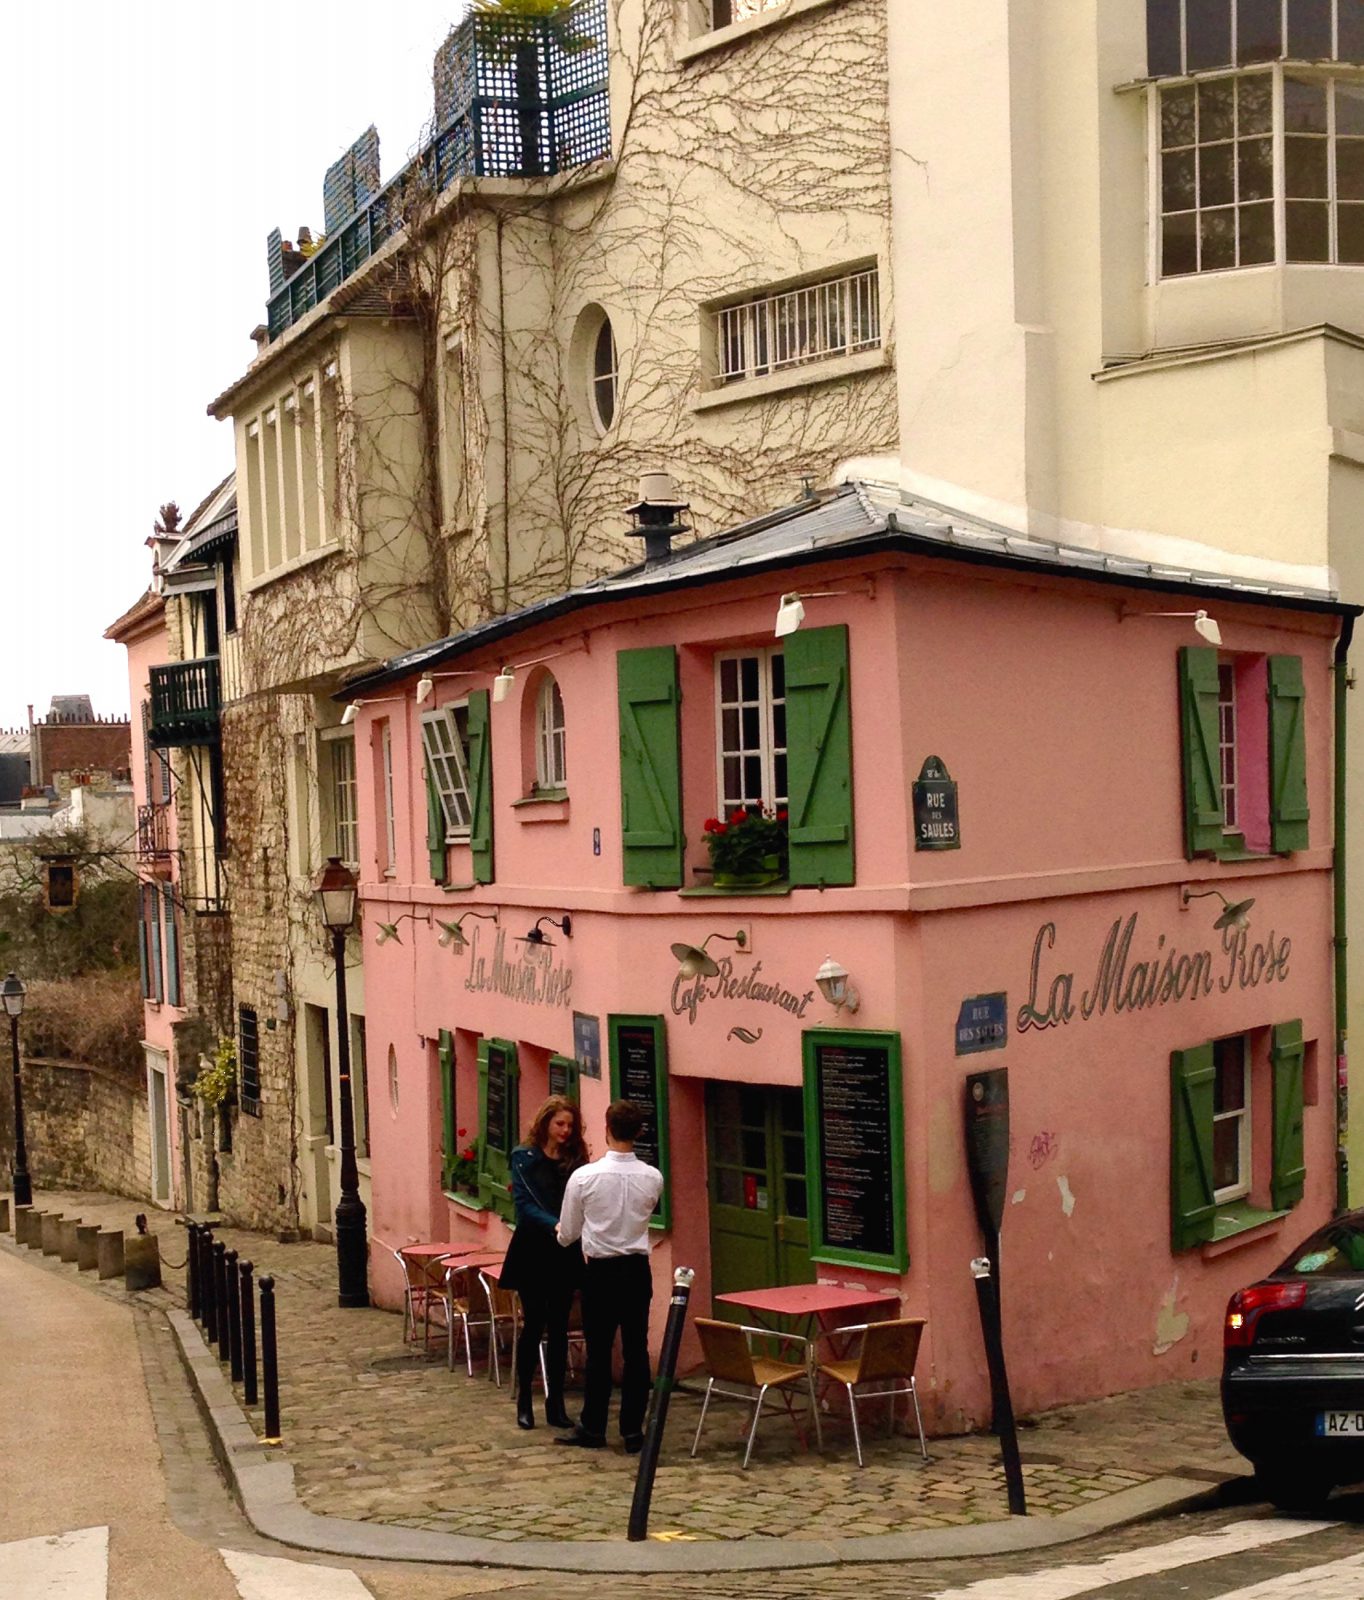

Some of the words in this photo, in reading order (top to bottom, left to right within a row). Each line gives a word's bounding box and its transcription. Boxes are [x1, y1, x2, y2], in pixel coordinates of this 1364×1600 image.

[927, 793, 946, 808] RUE
[921, 823, 955, 838] SAULES
[486, 928, 542, 1005] Maison
[1016, 921, 1075, 1033] La
[1081, 911, 1214, 1021] Maison
[1219, 921, 1292, 994] Rose
